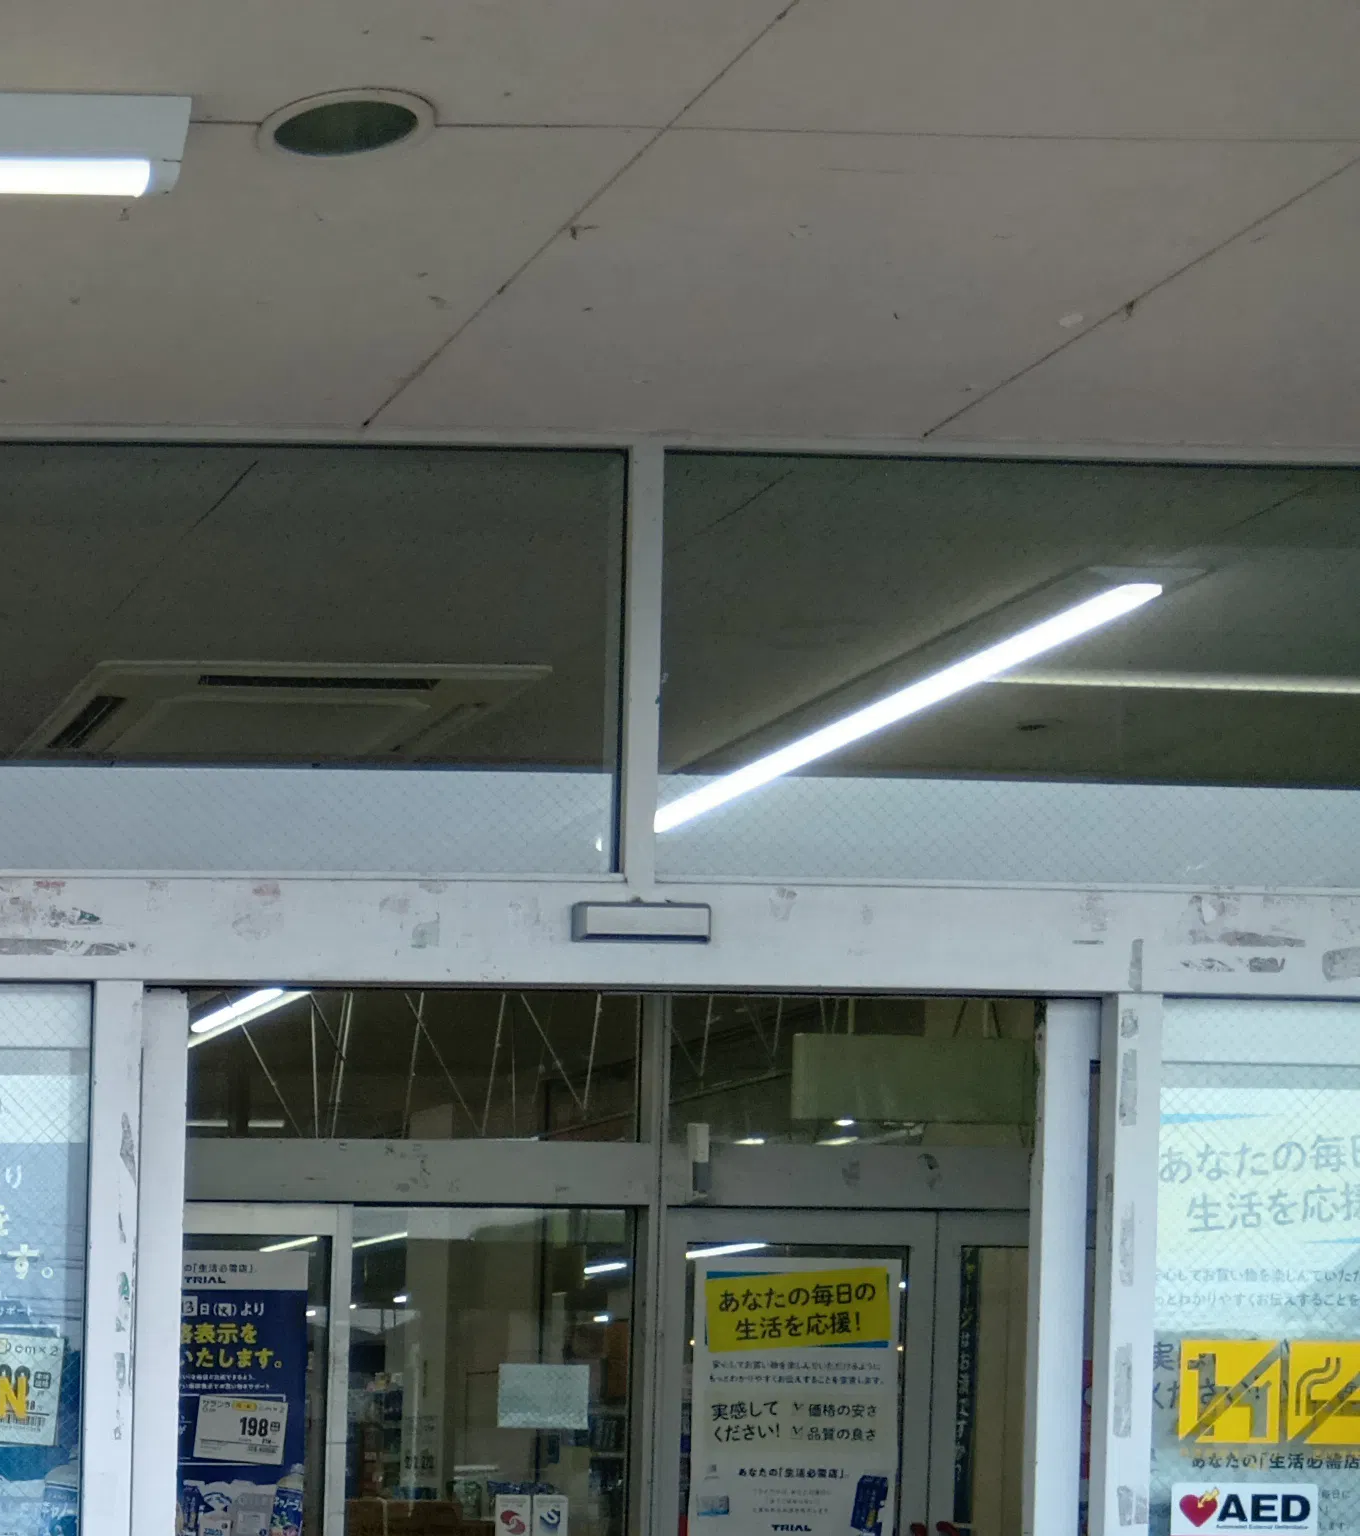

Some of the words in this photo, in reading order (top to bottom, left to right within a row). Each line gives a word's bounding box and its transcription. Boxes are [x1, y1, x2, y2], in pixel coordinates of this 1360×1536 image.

[183, 1276, 227, 1284] TRIAL
[718, 1282, 877, 1313] あなたの毎日の
[735, 1312, 862, 1341] 生活を応援!
[711, 1401, 779, 1421] 実感して
[808, 1403, 878, 1418] 価格の安さ
[240, 1416, 269, 1437] 198
[807, 1427, 877, 1441] 品質の良さ
[1217, 1493, 1311, 1523] AED
[771, 1524, 813, 1532] TRIAL
